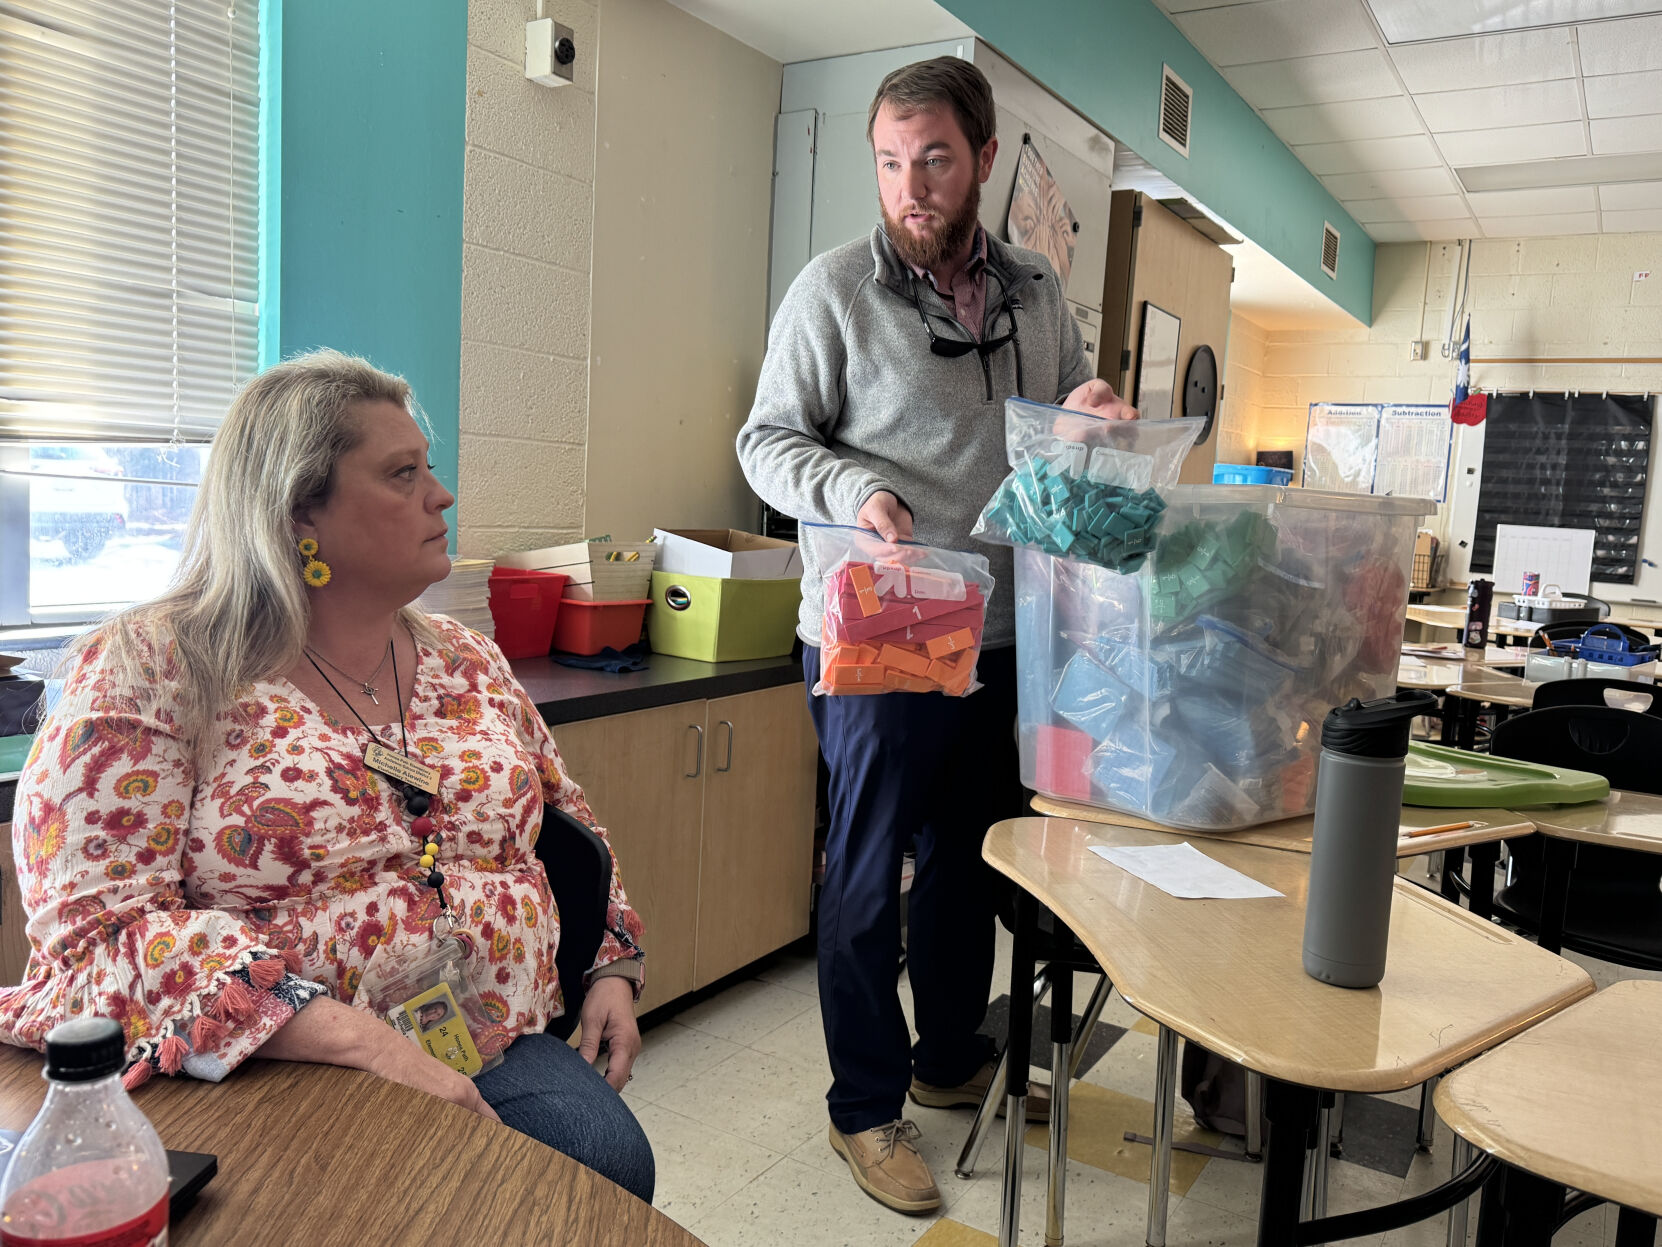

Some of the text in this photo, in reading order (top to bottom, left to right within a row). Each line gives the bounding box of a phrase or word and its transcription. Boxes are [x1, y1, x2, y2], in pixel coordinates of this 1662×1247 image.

[912, 605, 922, 620] 1
[372, 757, 402, 773] Michelle
[440, 1026, 449, 1037] 24
